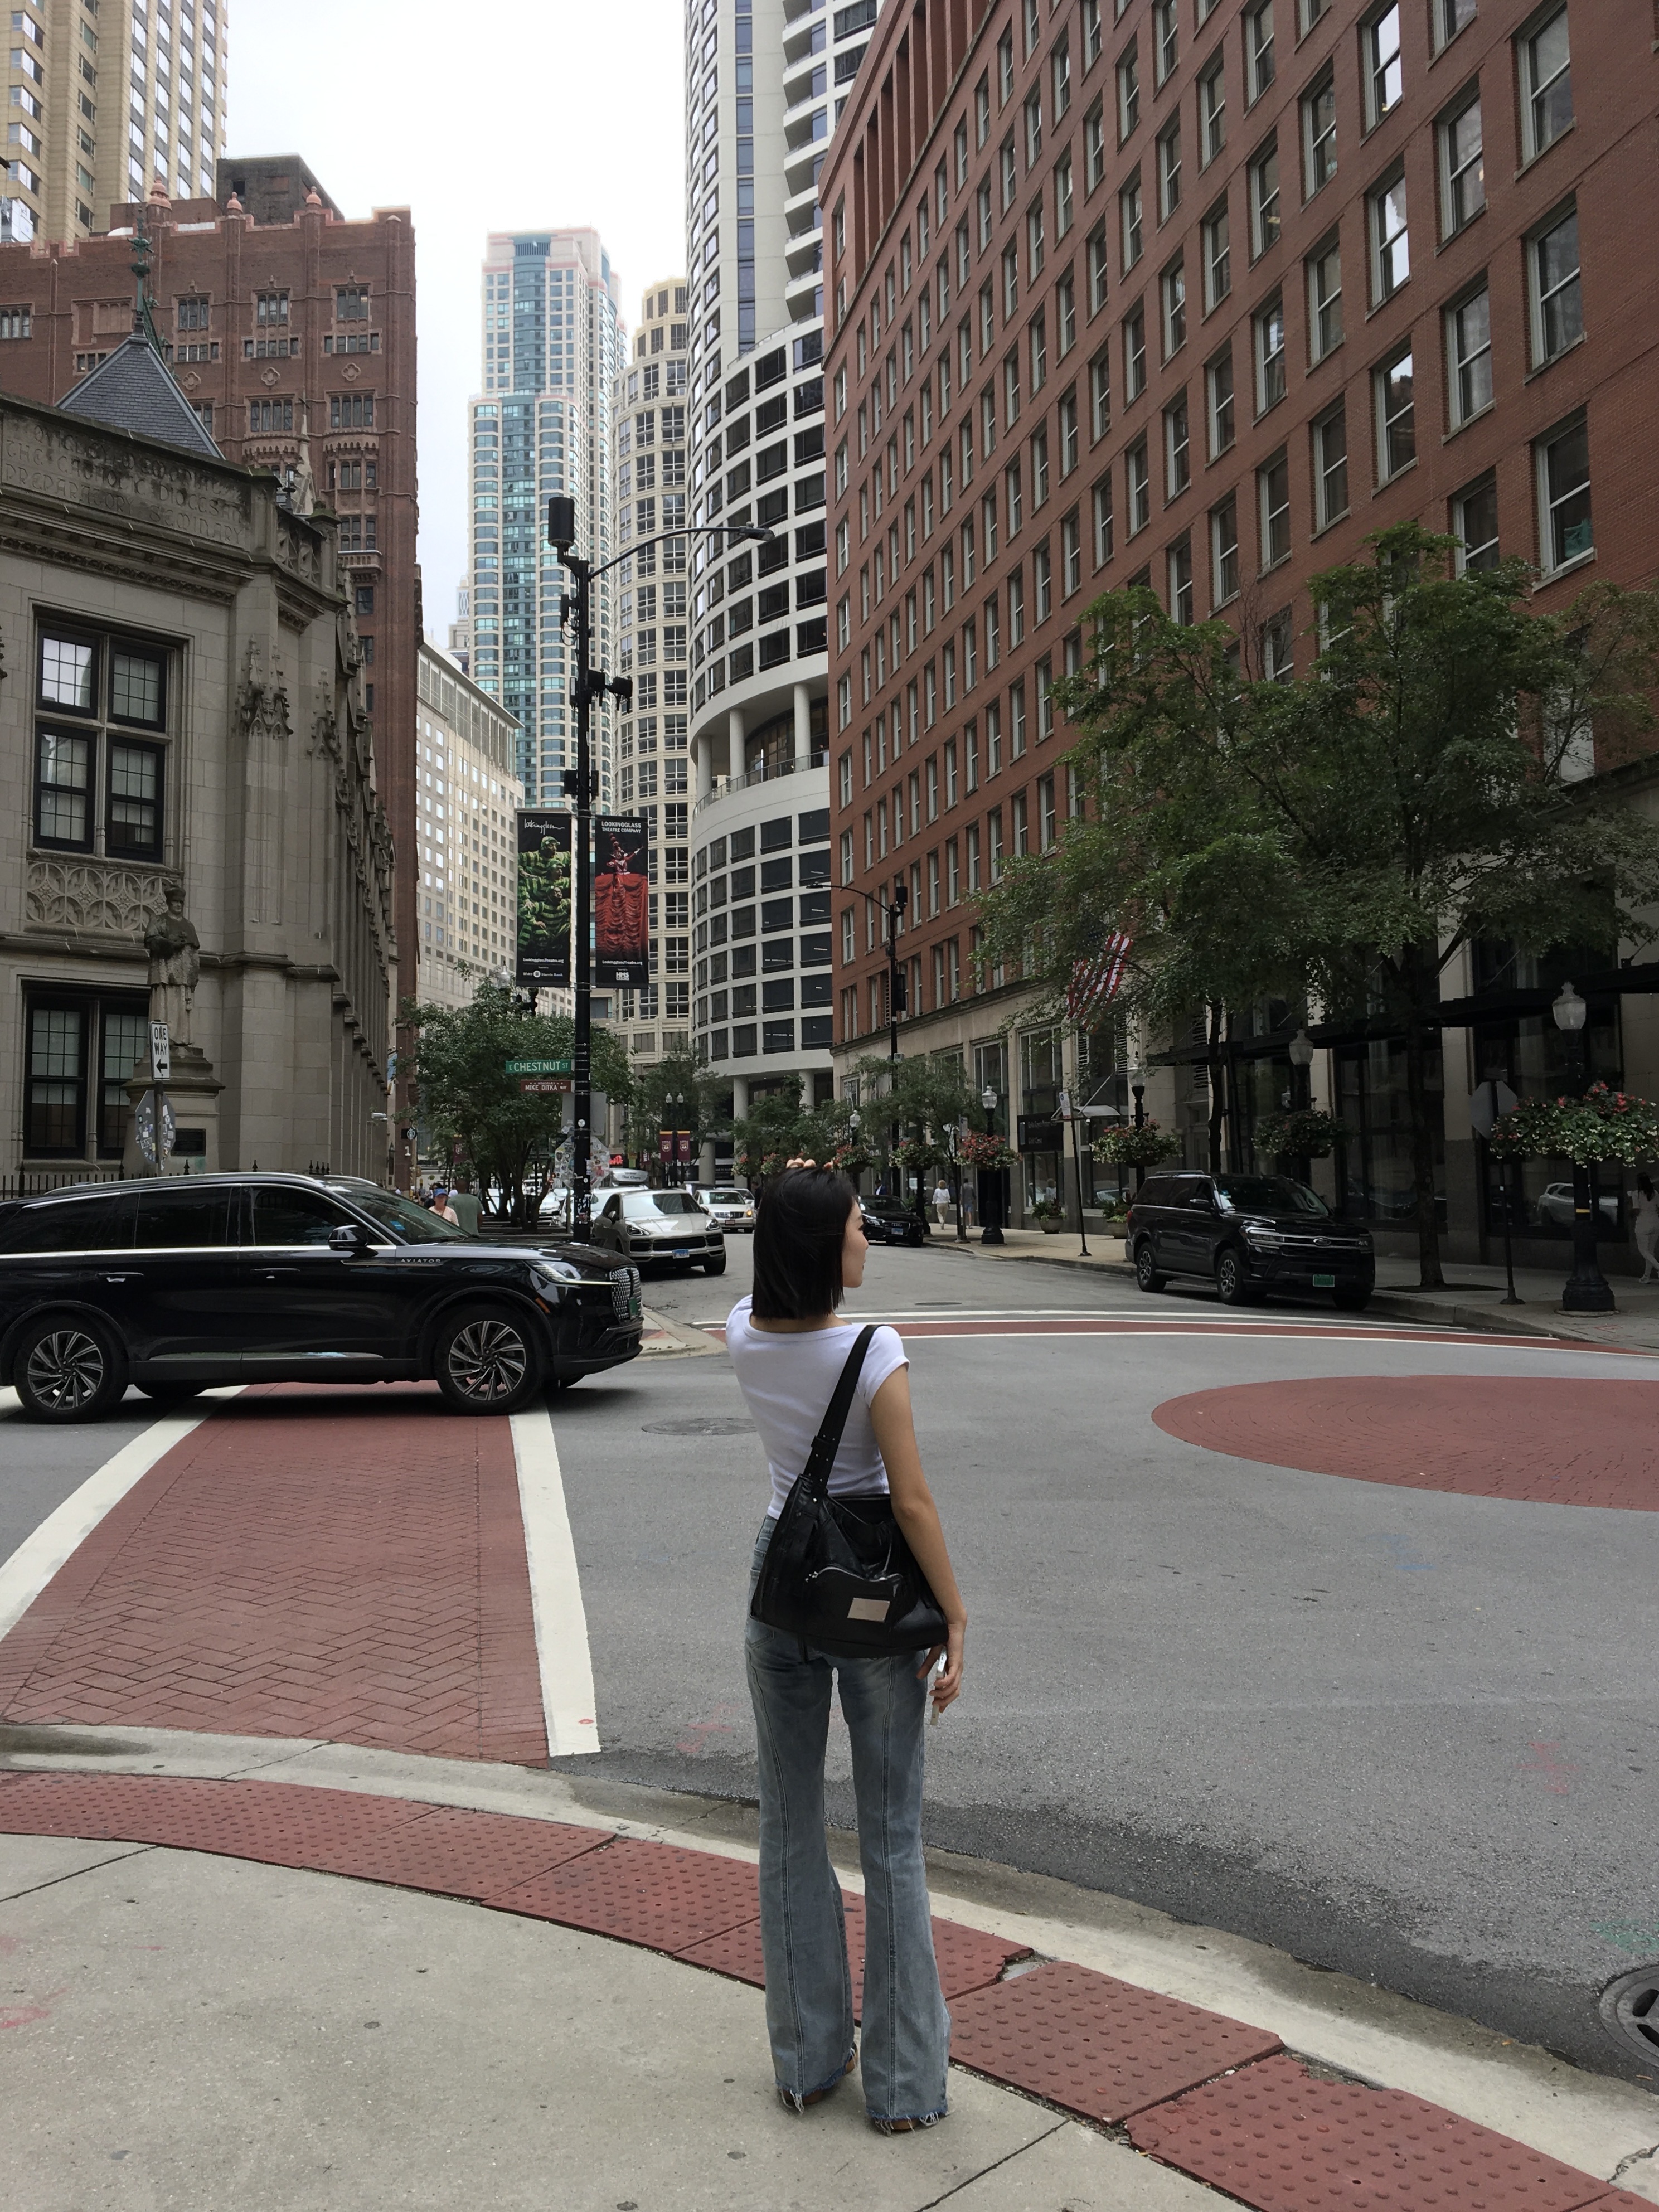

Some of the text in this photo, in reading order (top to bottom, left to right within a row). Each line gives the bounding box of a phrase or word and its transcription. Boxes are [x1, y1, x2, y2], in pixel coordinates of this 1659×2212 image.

[7, 439, 242, 523] THE CATHOLIC DIOCESAN
[6, 463, 242, 545] PREPARATORY SEMINARY
[154, 1027, 167, 1040] ONE
[154, 1042, 167, 1055] WAY
[514, 1061, 561, 1071] CHESTNUT
